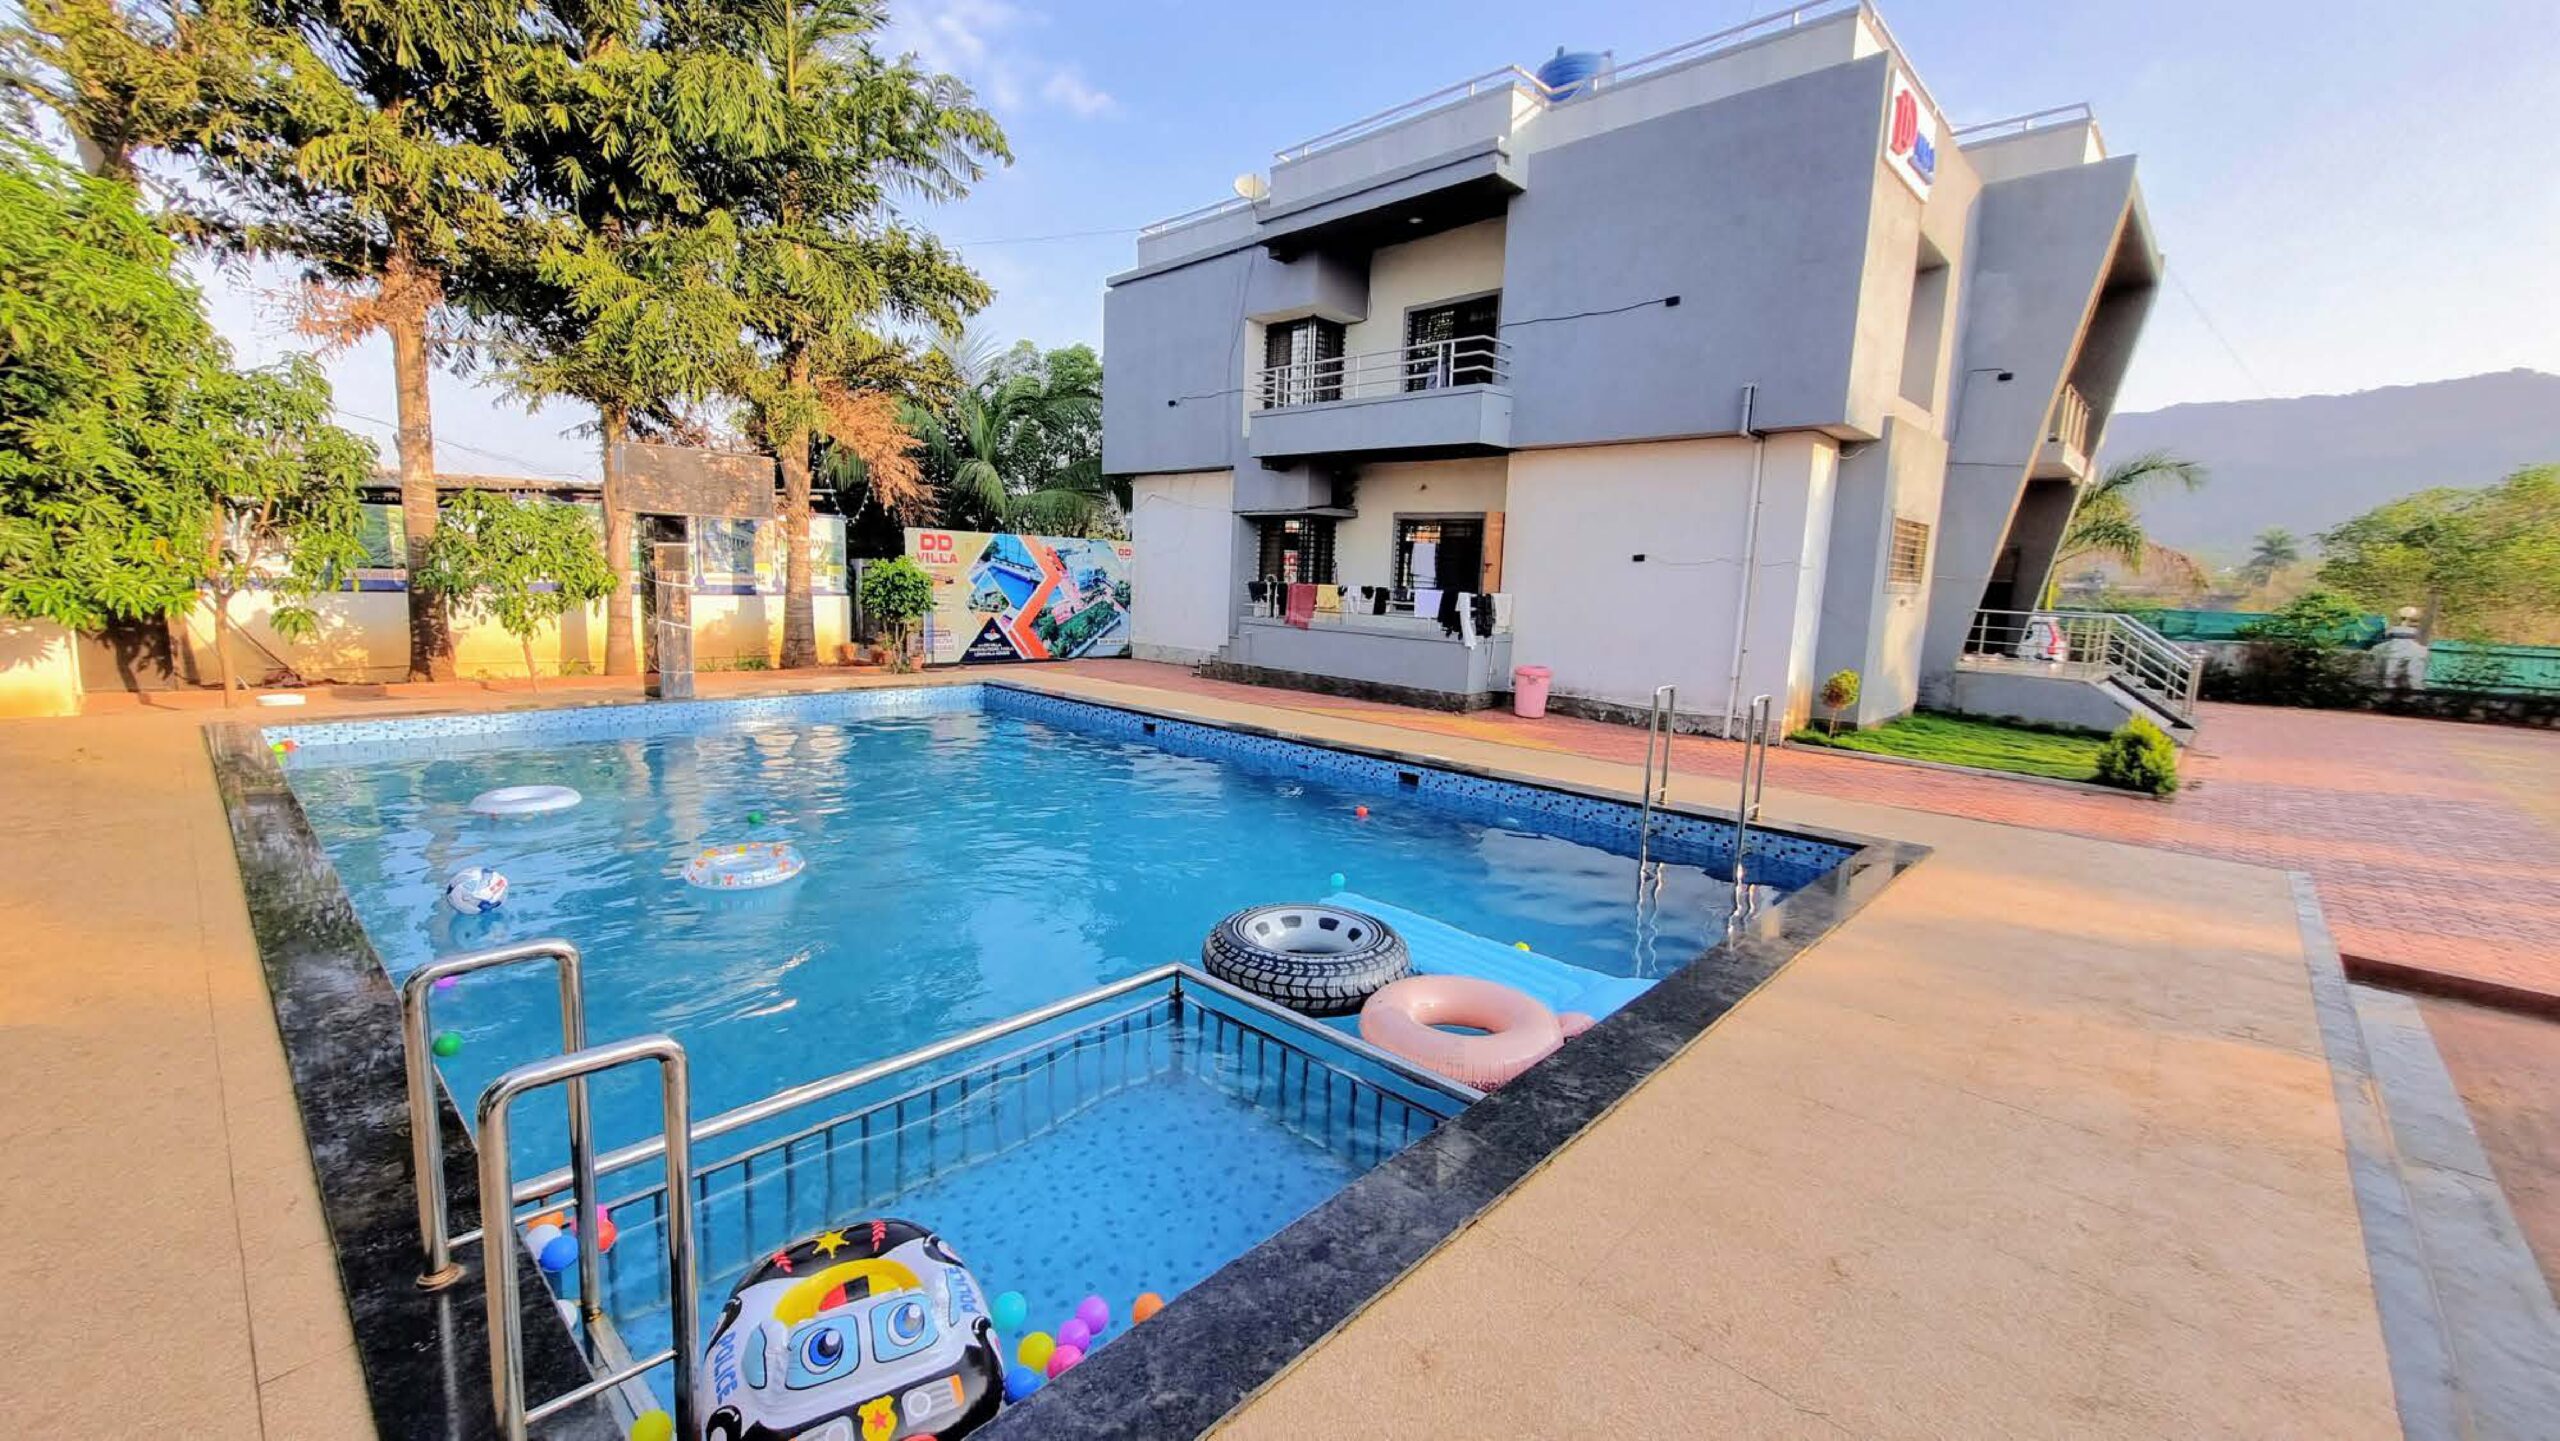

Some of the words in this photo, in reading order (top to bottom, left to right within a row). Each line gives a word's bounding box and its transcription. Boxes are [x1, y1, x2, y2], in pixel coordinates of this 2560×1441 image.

[920, 534, 953, 551] DD
[917, 552, 958, 564] VILLA
[714, 1331, 738, 1405] POLICE
